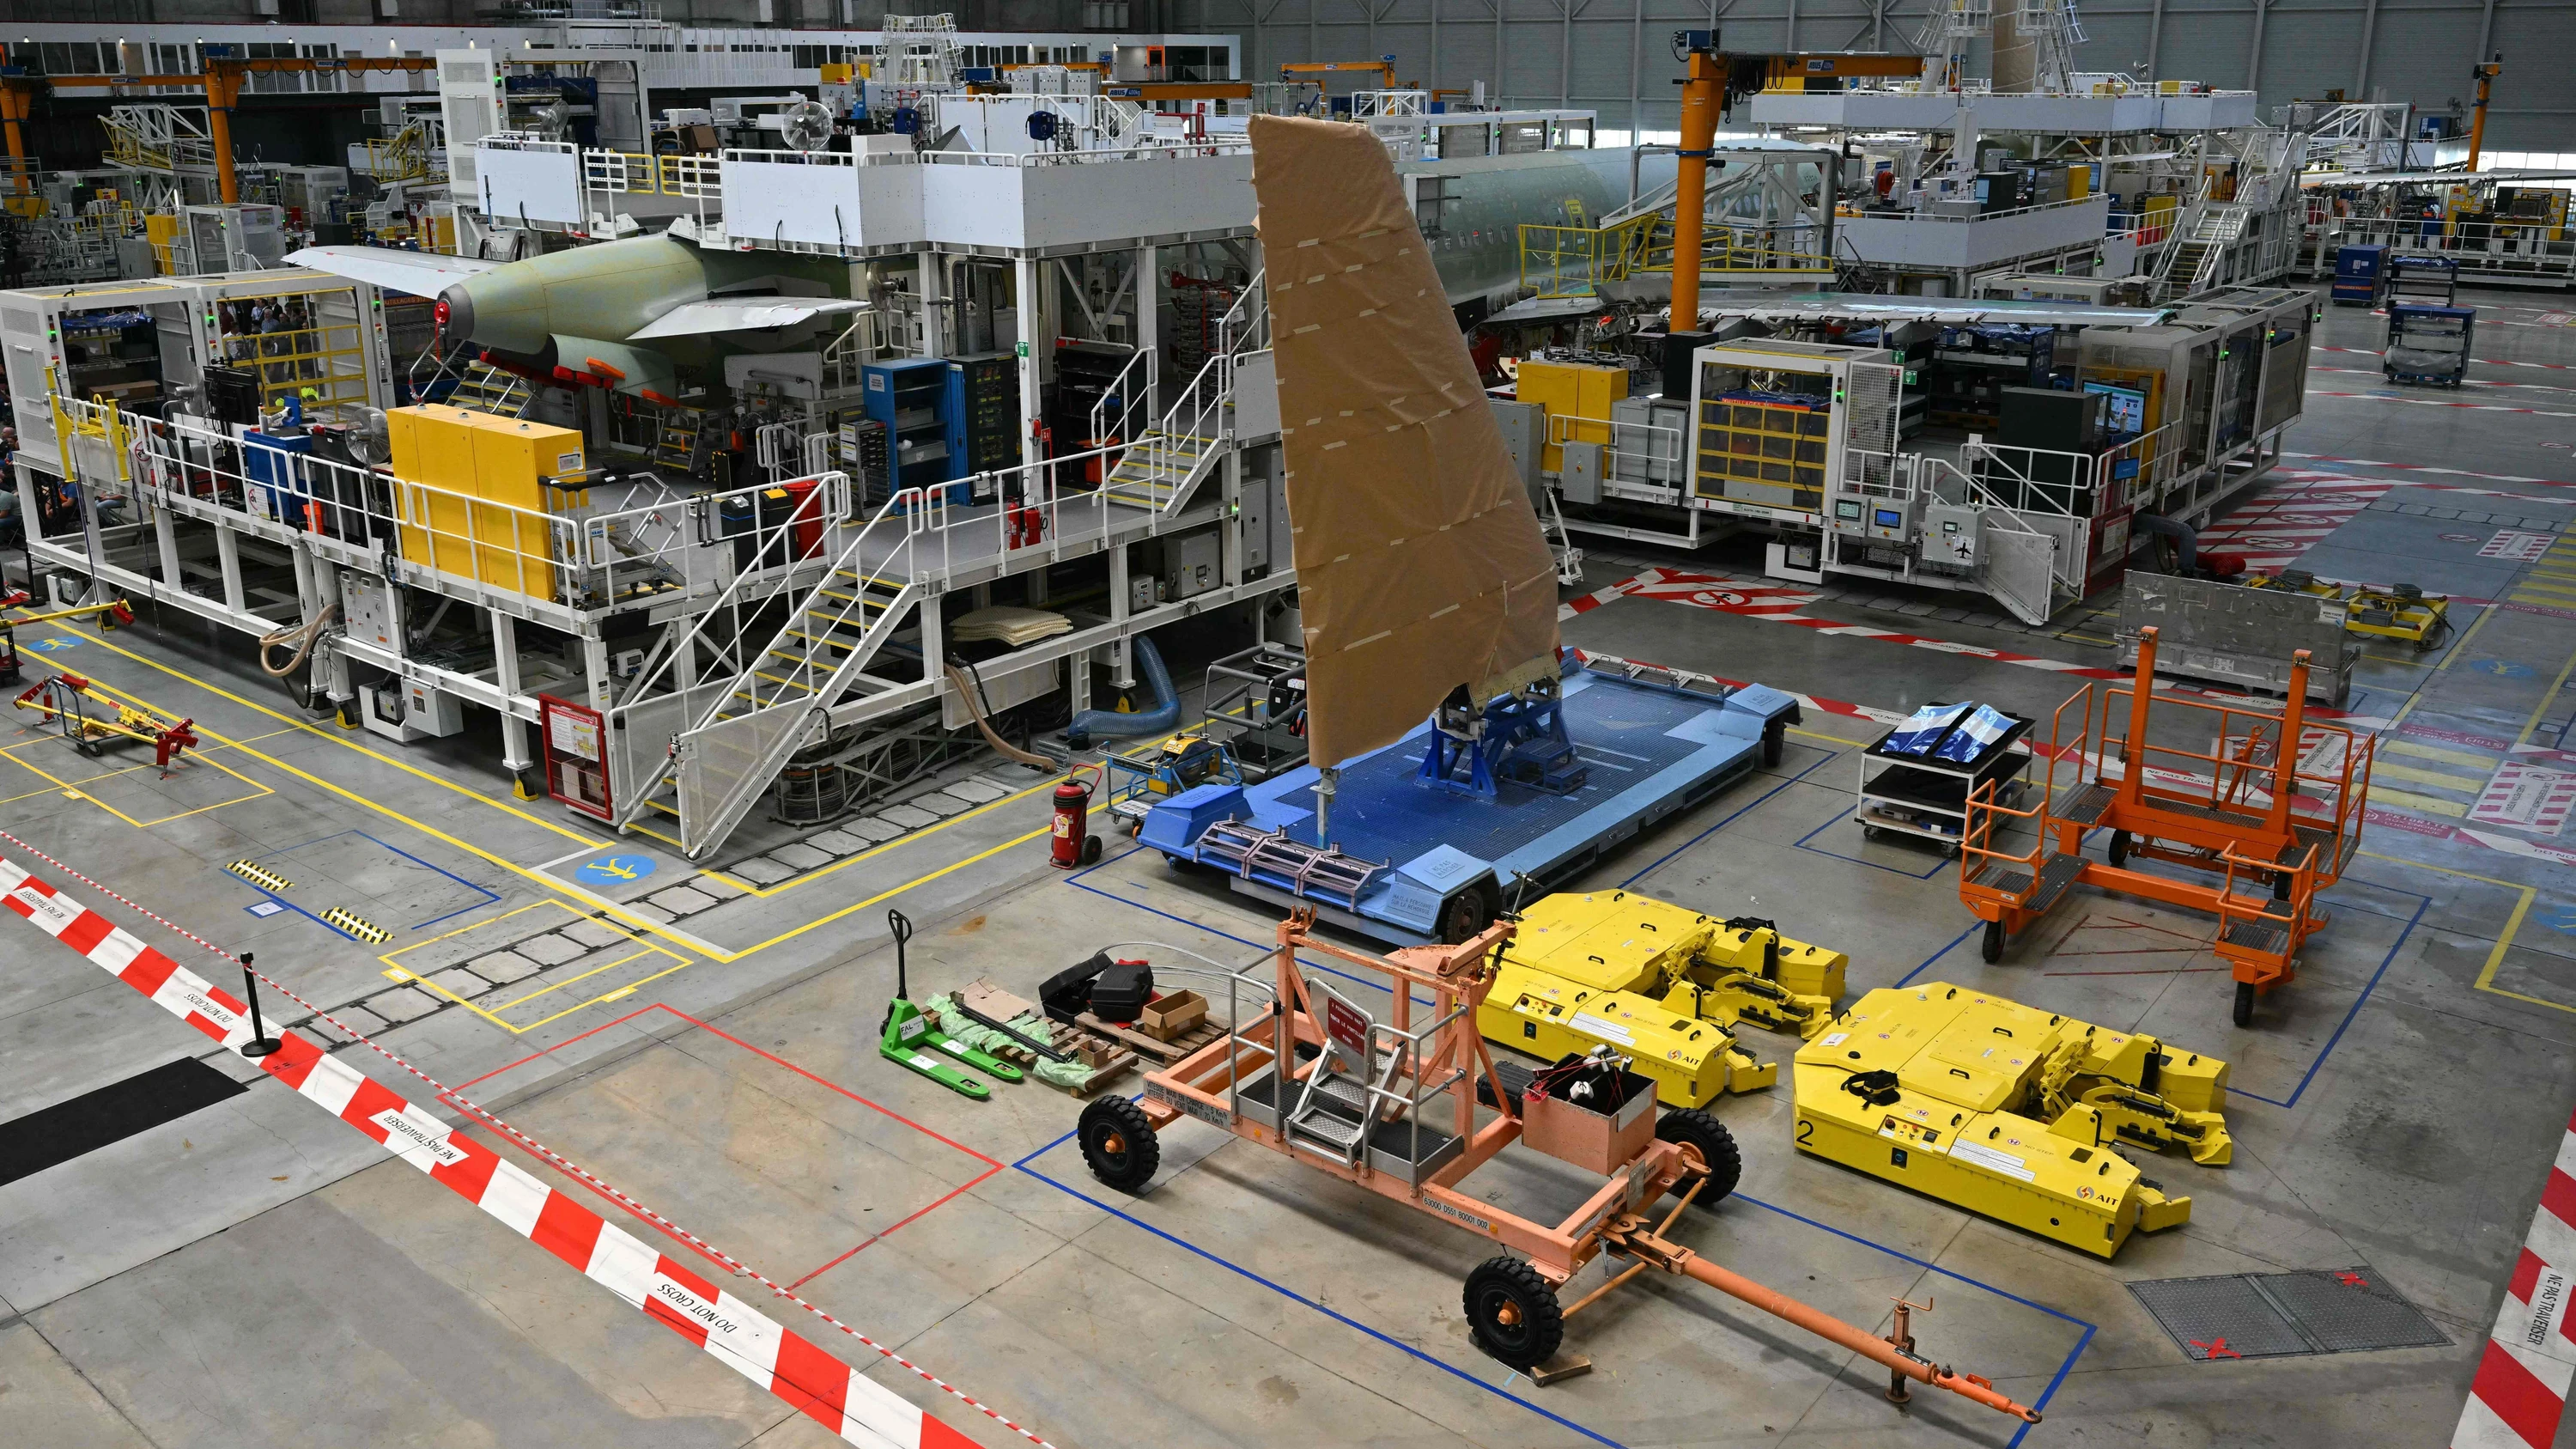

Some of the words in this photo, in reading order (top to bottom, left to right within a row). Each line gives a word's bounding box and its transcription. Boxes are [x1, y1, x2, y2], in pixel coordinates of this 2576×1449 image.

[2468, 739, 2500, 747] STOP
[2385, 813, 2449, 830] PRIORITE
[1408, 905, 1430, 916] REMORQUE
[1409, 898, 1434, 910] PERSONNES
[901, 1023, 914, 1033] FAL
[1681, 1056, 1700, 1065] AIT
[1146, 1081, 1164, 1094] VITESSE
[1166, 1088, 1177, 1099] MAXI
[1178, 1093, 1185, 1101] EN
[1186, 1097, 1204, 1111] CHARGE
[1216, 1110, 1228, 1120] Km/h
[1146, 1089, 1164, 1102] VITESSE
[1166, 1096, 1173, 1105] DU
[1174, 1100, 1185, 1110] VENT
[1187, 1104, 1198, 1116] MAXI
[1204, 1111, 1210, 1120] 70
[1212, 1116, 1224, 1126] Km/h
[383, 1115, 429, 1144] TRAVERSER
[1796, 1119, 1814, 1148] 2
[423, 1139, 445, 1153] PAS
[439, 1149, 457, 1160] NE
[2096, 1195, 2118, 1206] AIT
[1424, 1197, 1442, 1210] 63000
[1443, 1205, 1456, 1216] D551
[1458, 1211, 1475, 1224] 80001
[1476, 1219, 1488, 1229] 002
[2547, 1273, 2563, 1288] NE
[657, 1283, 695, 1307] CROSS
[2542, 1285, 2560, 1302] PAS
[690, 1305, 720, 1322] NOT
[714, 1318, 738, 1334] DO
[2526, 1300, 2555, 1346] TRAVERSER
